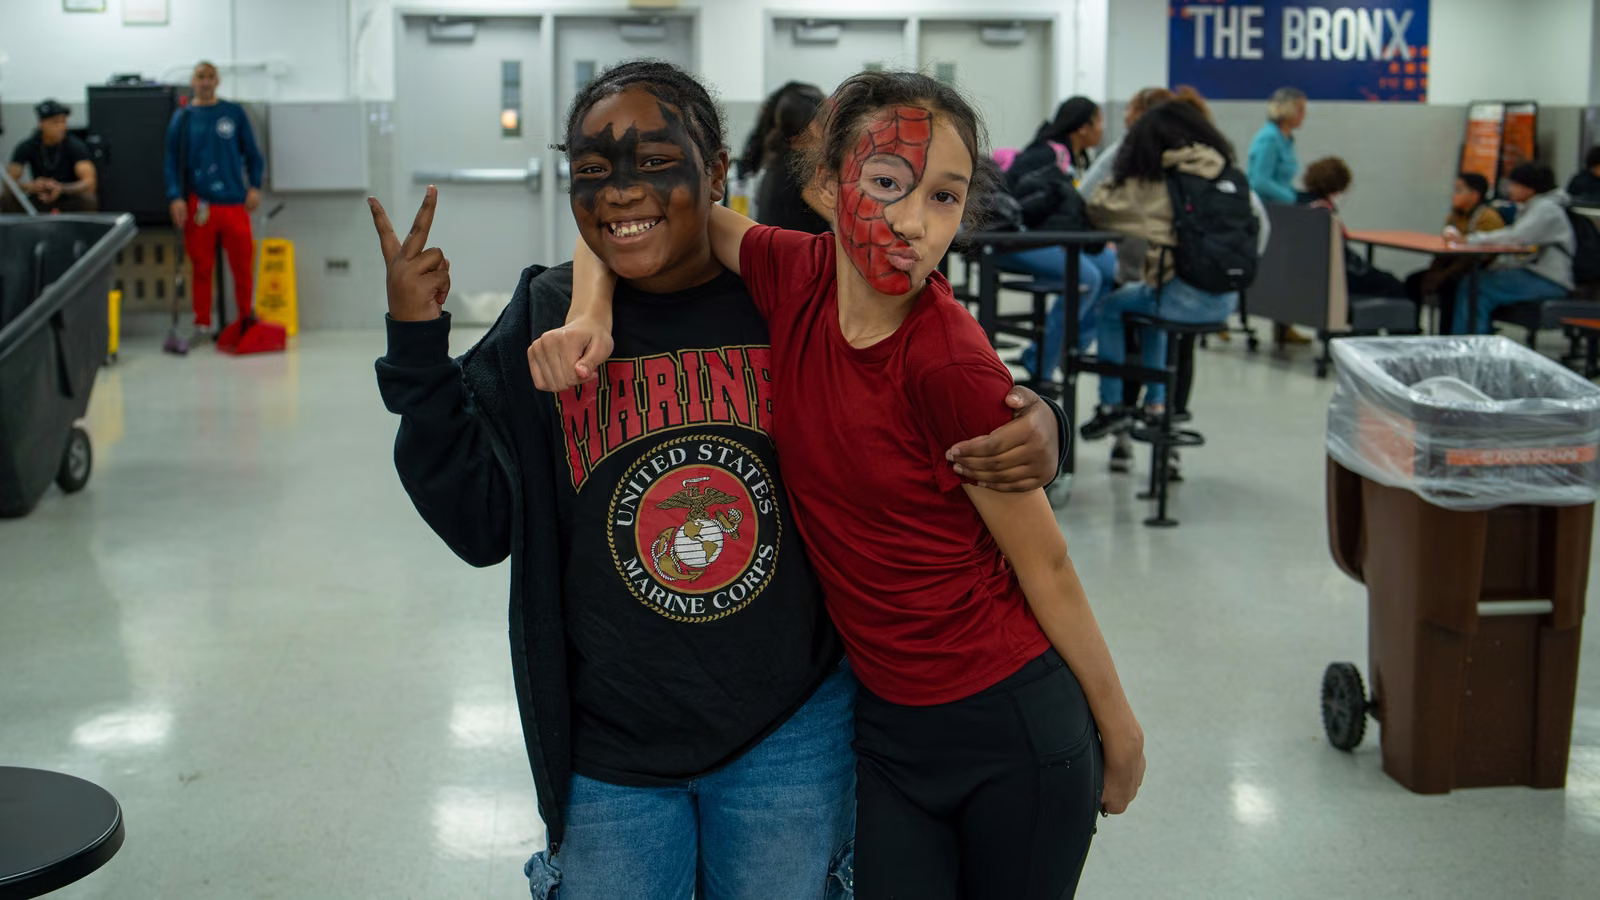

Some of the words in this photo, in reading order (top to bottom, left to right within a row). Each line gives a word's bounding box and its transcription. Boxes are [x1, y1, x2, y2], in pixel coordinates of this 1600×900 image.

[1187, 6, 1265, 60] THE
[1281, 6, 1414, 61] BRONX
[616, 447, 687, 527] UNITED
[697, 443, 773, 515] STATES
[623, 556, 706, 615] MARINE
[712, 543, 774, 609] CORPS
